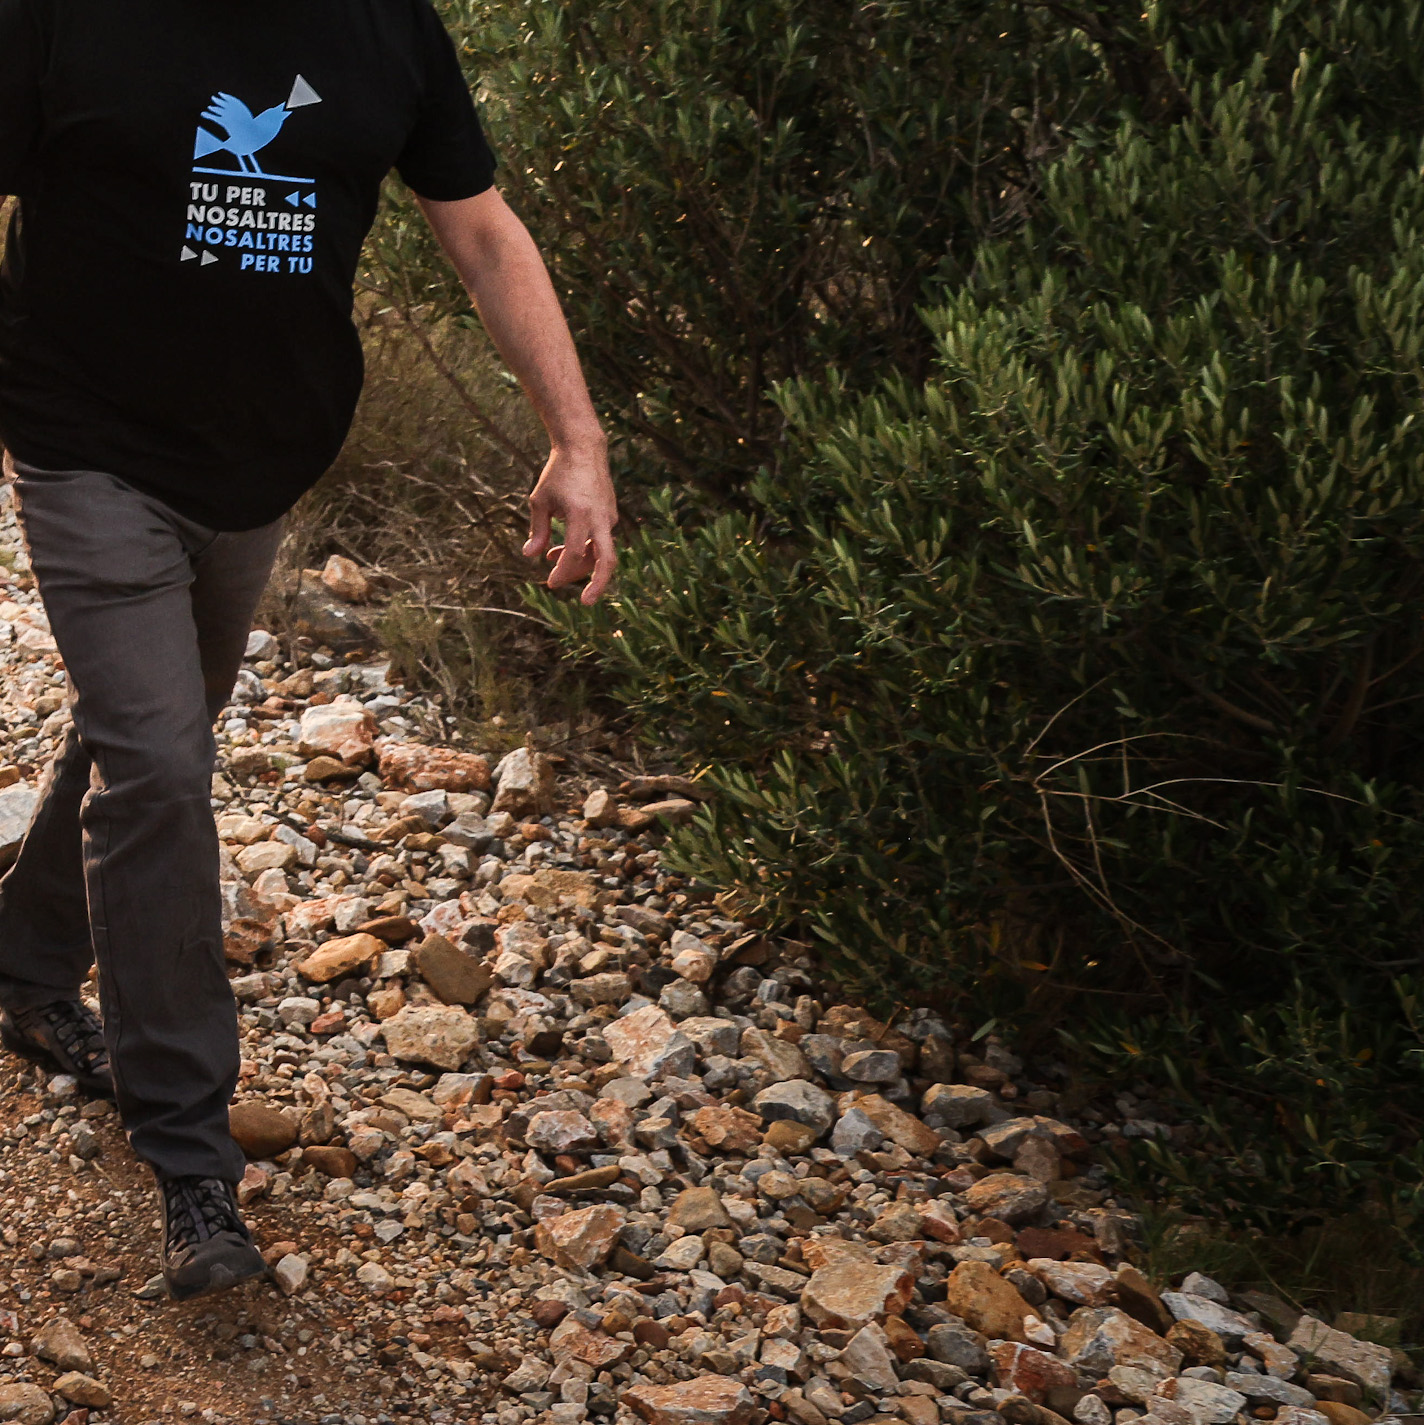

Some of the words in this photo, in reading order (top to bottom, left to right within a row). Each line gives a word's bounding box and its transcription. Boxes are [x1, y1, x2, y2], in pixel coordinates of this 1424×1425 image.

[189, 182, 219, 202] TU
[225, 186, 266, 206] PER
[187, 204, 315, 232] NOSALTRES
[185, 223, 314, 252] NOSALTRES
[240, 254, 280, 273] PER
[287, 257, 313, 274] TU
